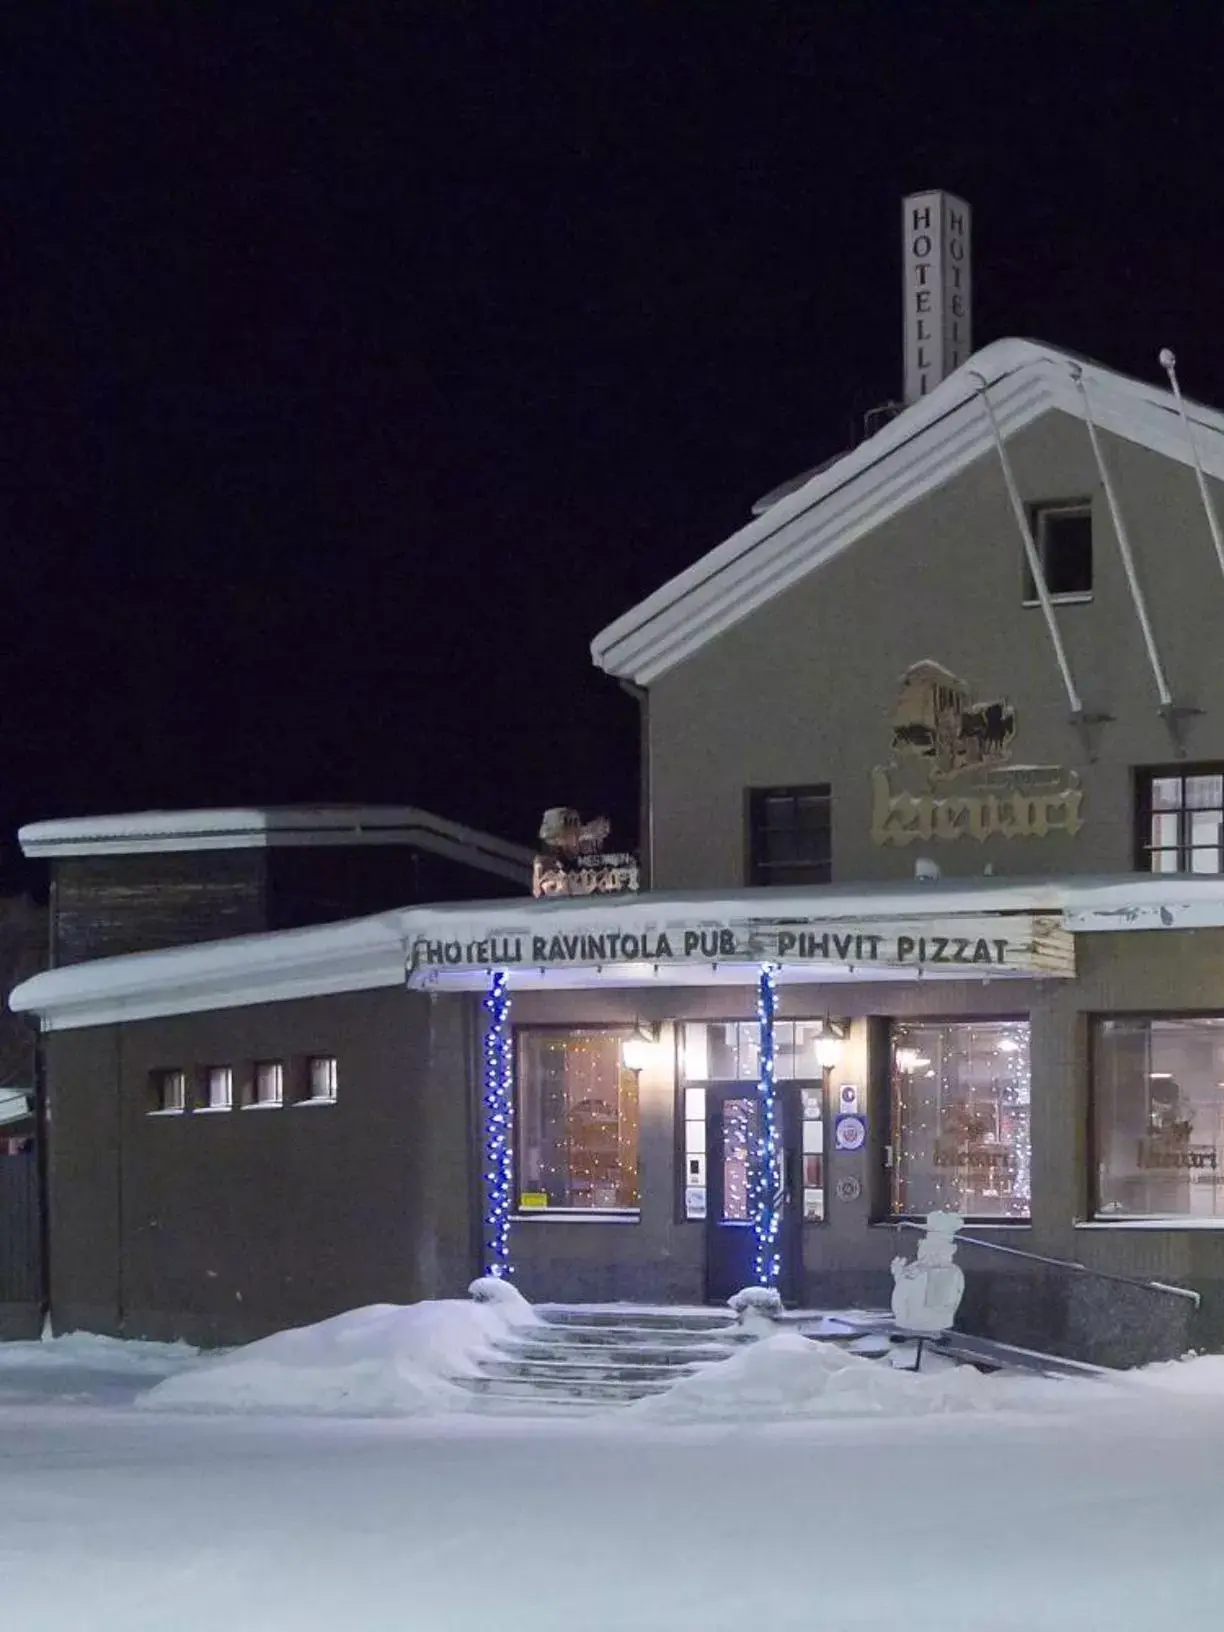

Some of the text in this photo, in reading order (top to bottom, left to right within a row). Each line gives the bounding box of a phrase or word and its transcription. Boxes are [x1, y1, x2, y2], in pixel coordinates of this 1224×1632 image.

[912, 206, 932, 396] HOTELLI
[425, 927, 736, 964] HOTELLI RAVINTOLA PUB
[777, 932, 1008, 964] PIHVIT PIZZAT
